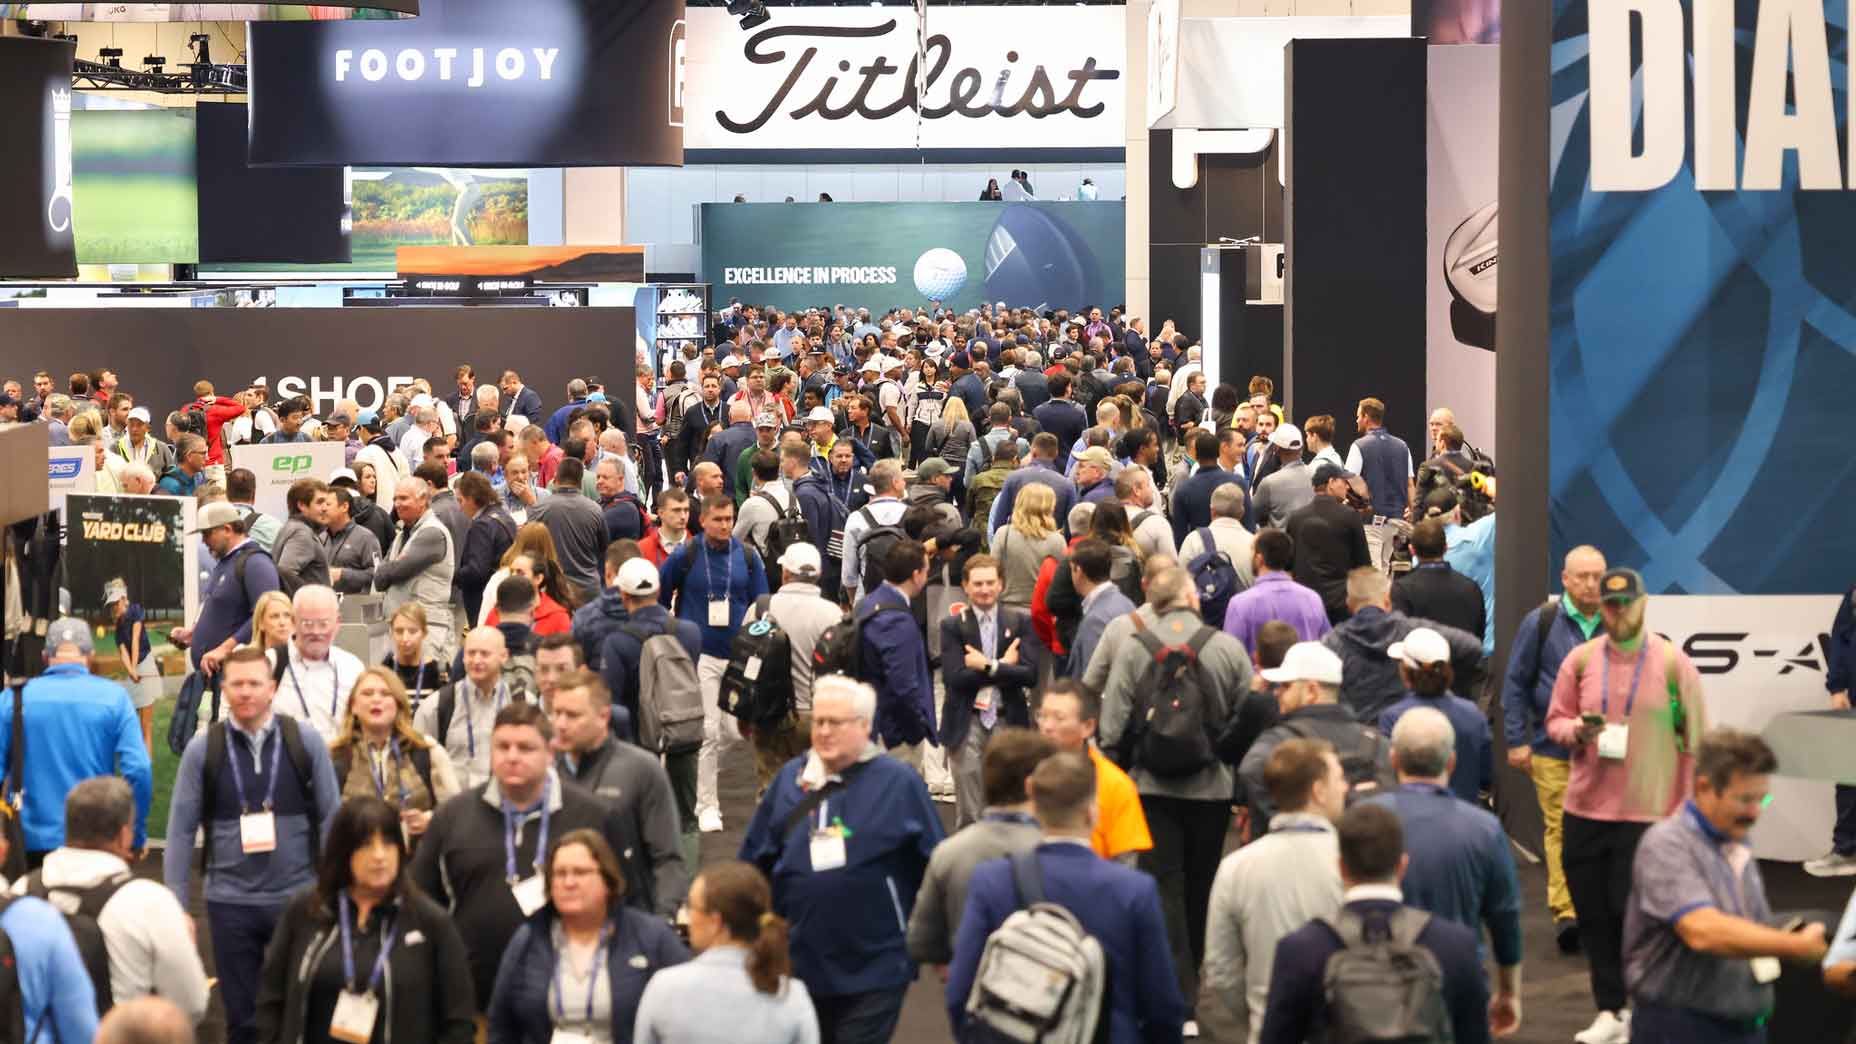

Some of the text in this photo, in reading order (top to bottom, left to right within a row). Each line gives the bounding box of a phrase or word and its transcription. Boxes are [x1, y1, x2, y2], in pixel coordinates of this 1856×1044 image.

[715, 19, 1120, 134] Titleist
[1588, 0, 1856, 191] DIA
[724, 266, 897, 285] EXCELLENCE IN PROCESS
[272, 455, 312, 474] ep
[82, 520, 167, 543] YARD CLUB
